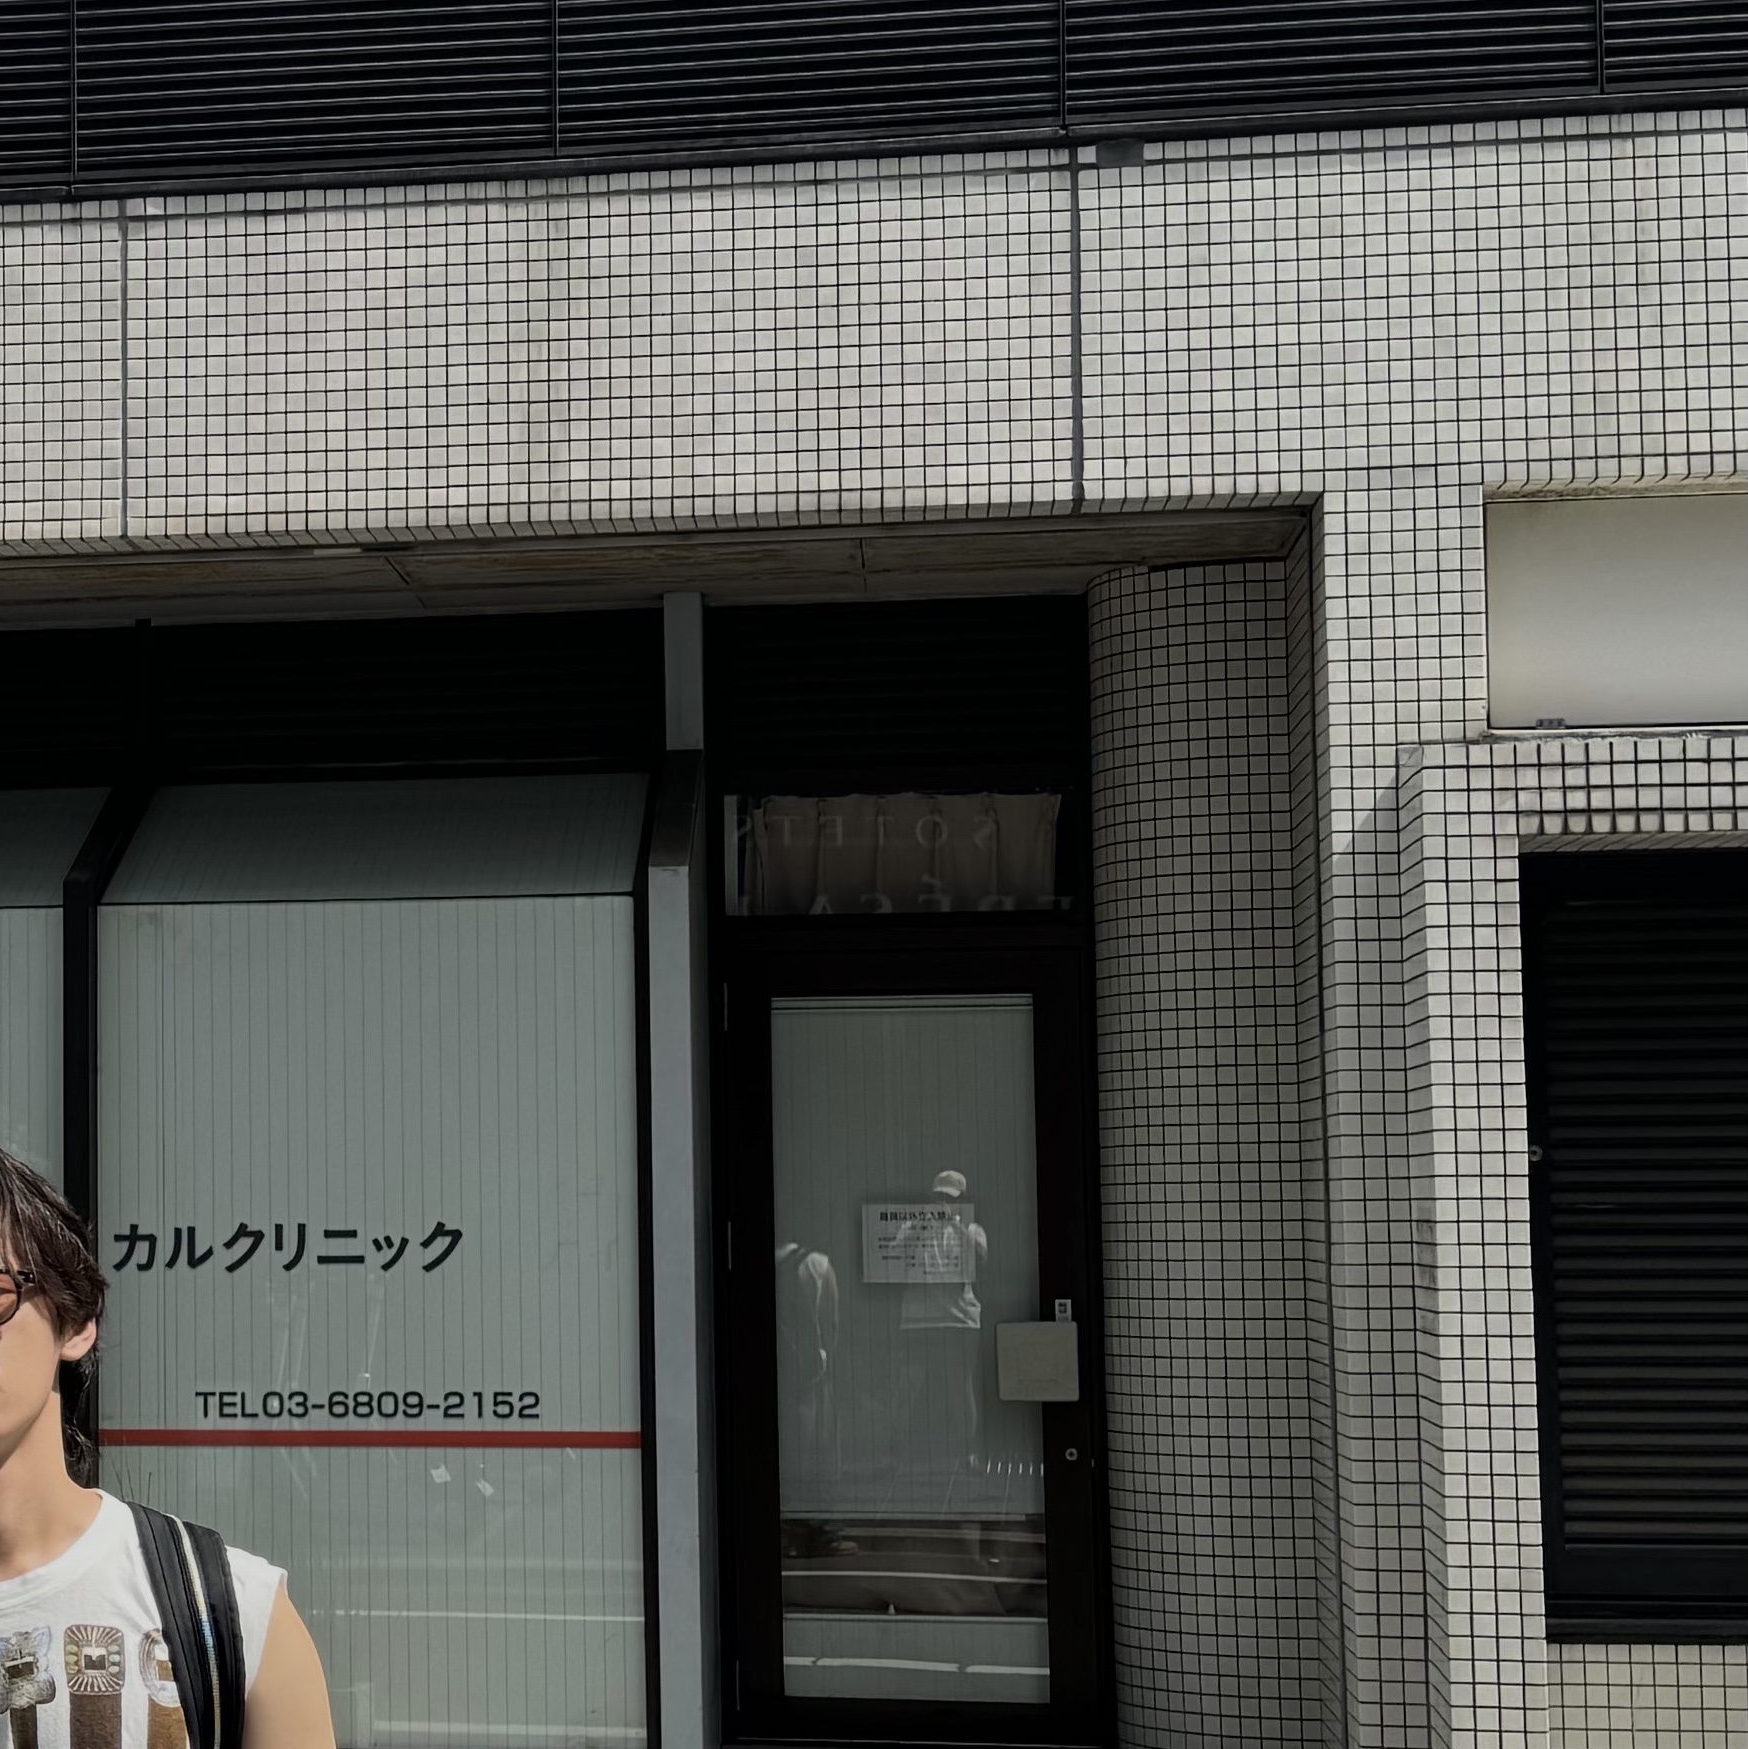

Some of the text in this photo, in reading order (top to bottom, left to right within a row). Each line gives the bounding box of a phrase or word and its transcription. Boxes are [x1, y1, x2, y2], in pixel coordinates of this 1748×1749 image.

[113, 1221, 463, 1273] カルクリニック
